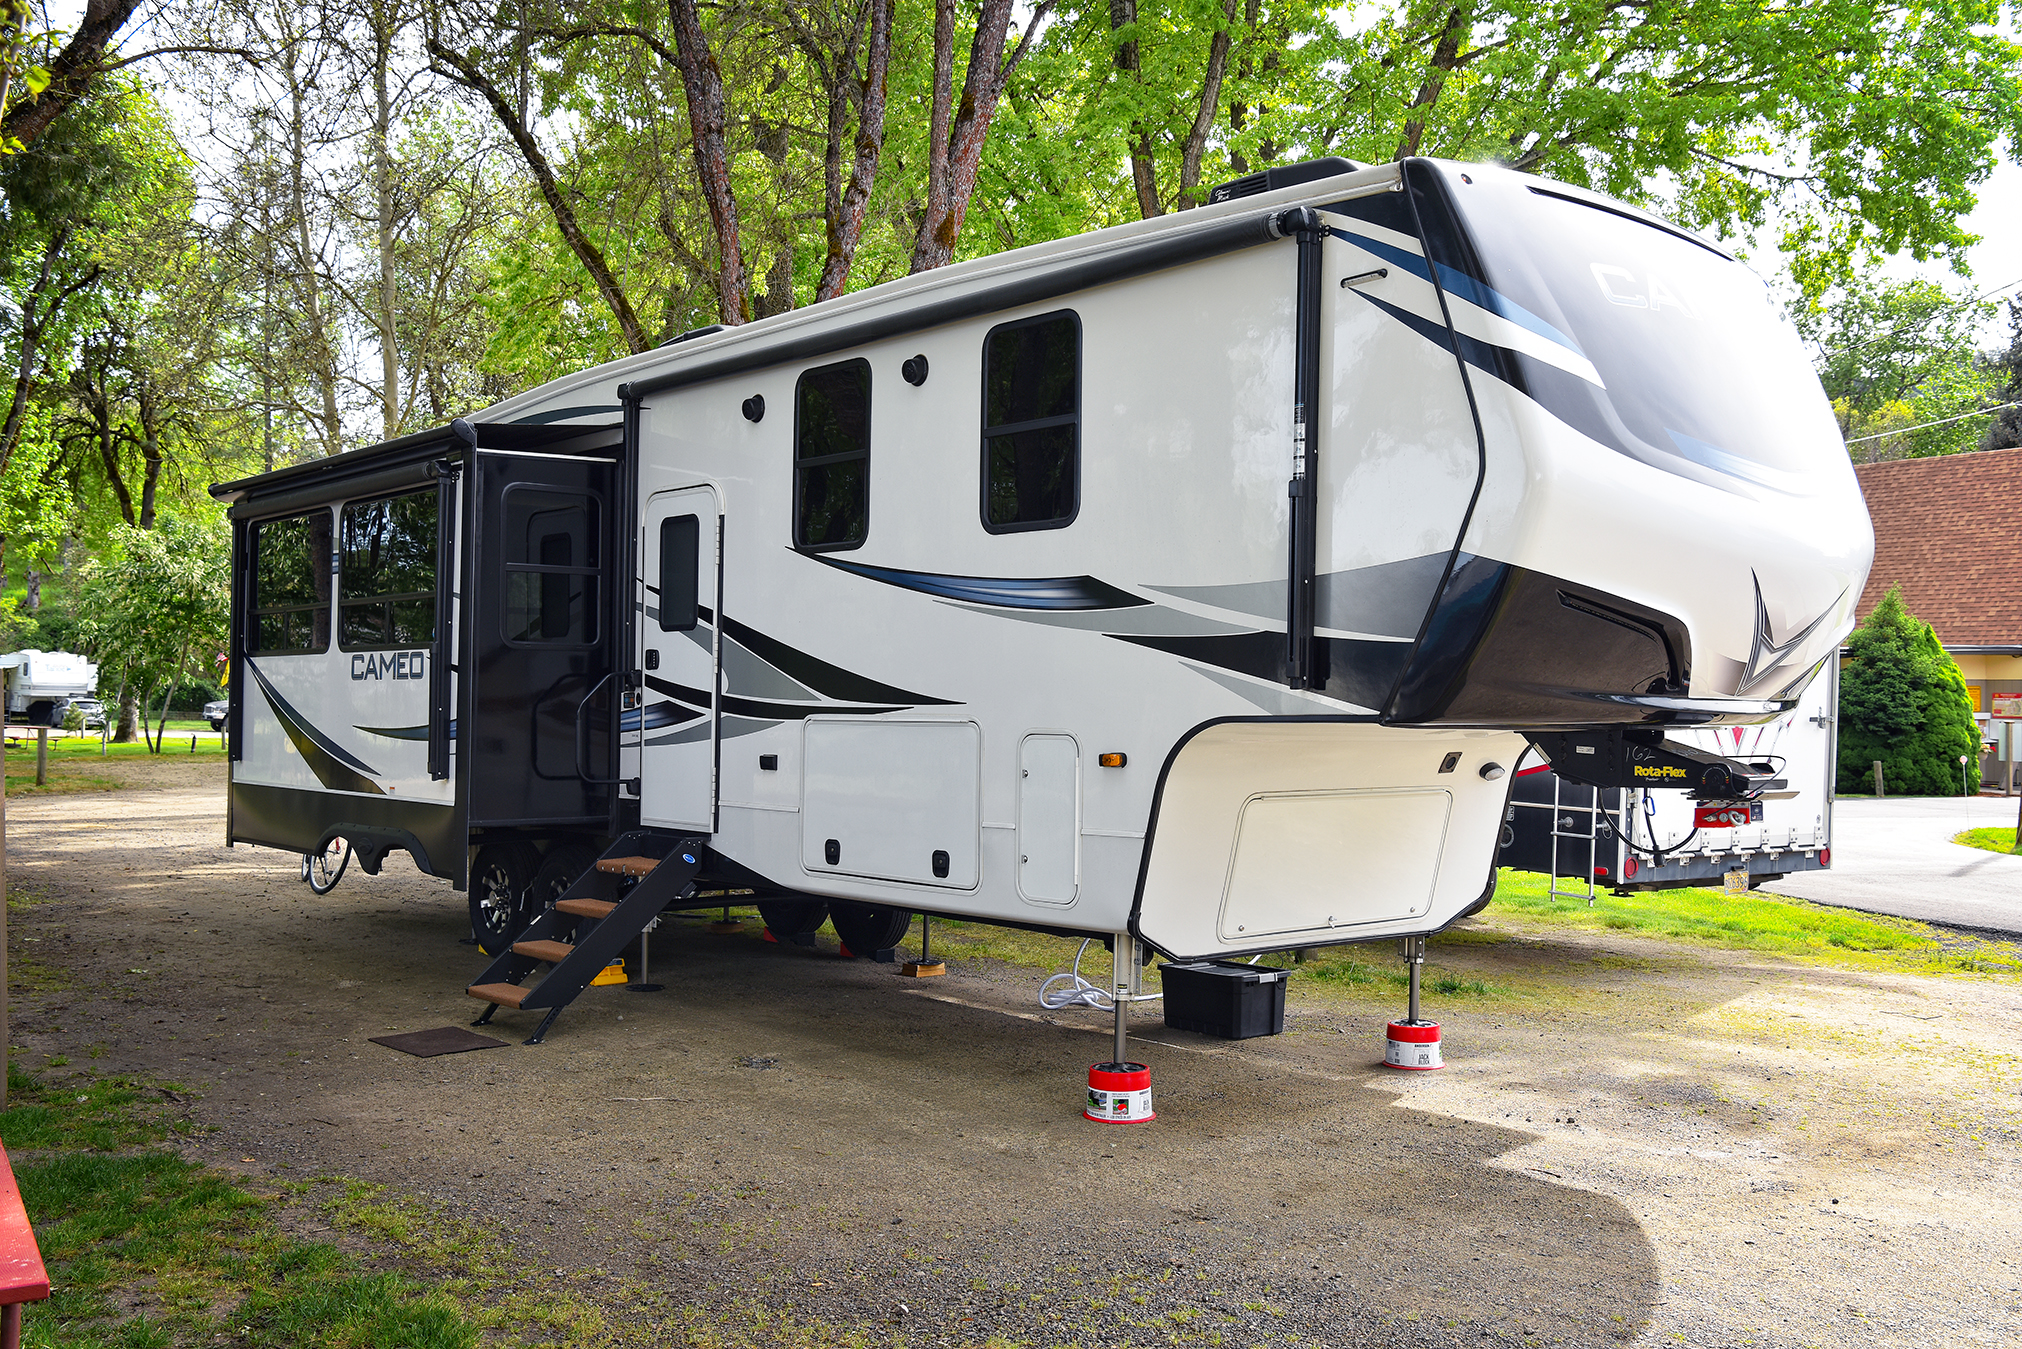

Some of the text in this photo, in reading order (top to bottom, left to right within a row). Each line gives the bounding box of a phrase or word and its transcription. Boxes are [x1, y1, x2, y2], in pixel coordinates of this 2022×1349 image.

[351, 651, 424, 681] CAMEO
[1625, 746, 1656, 762] 162
[1634, 765, 1687, 778] Rota-Flex
